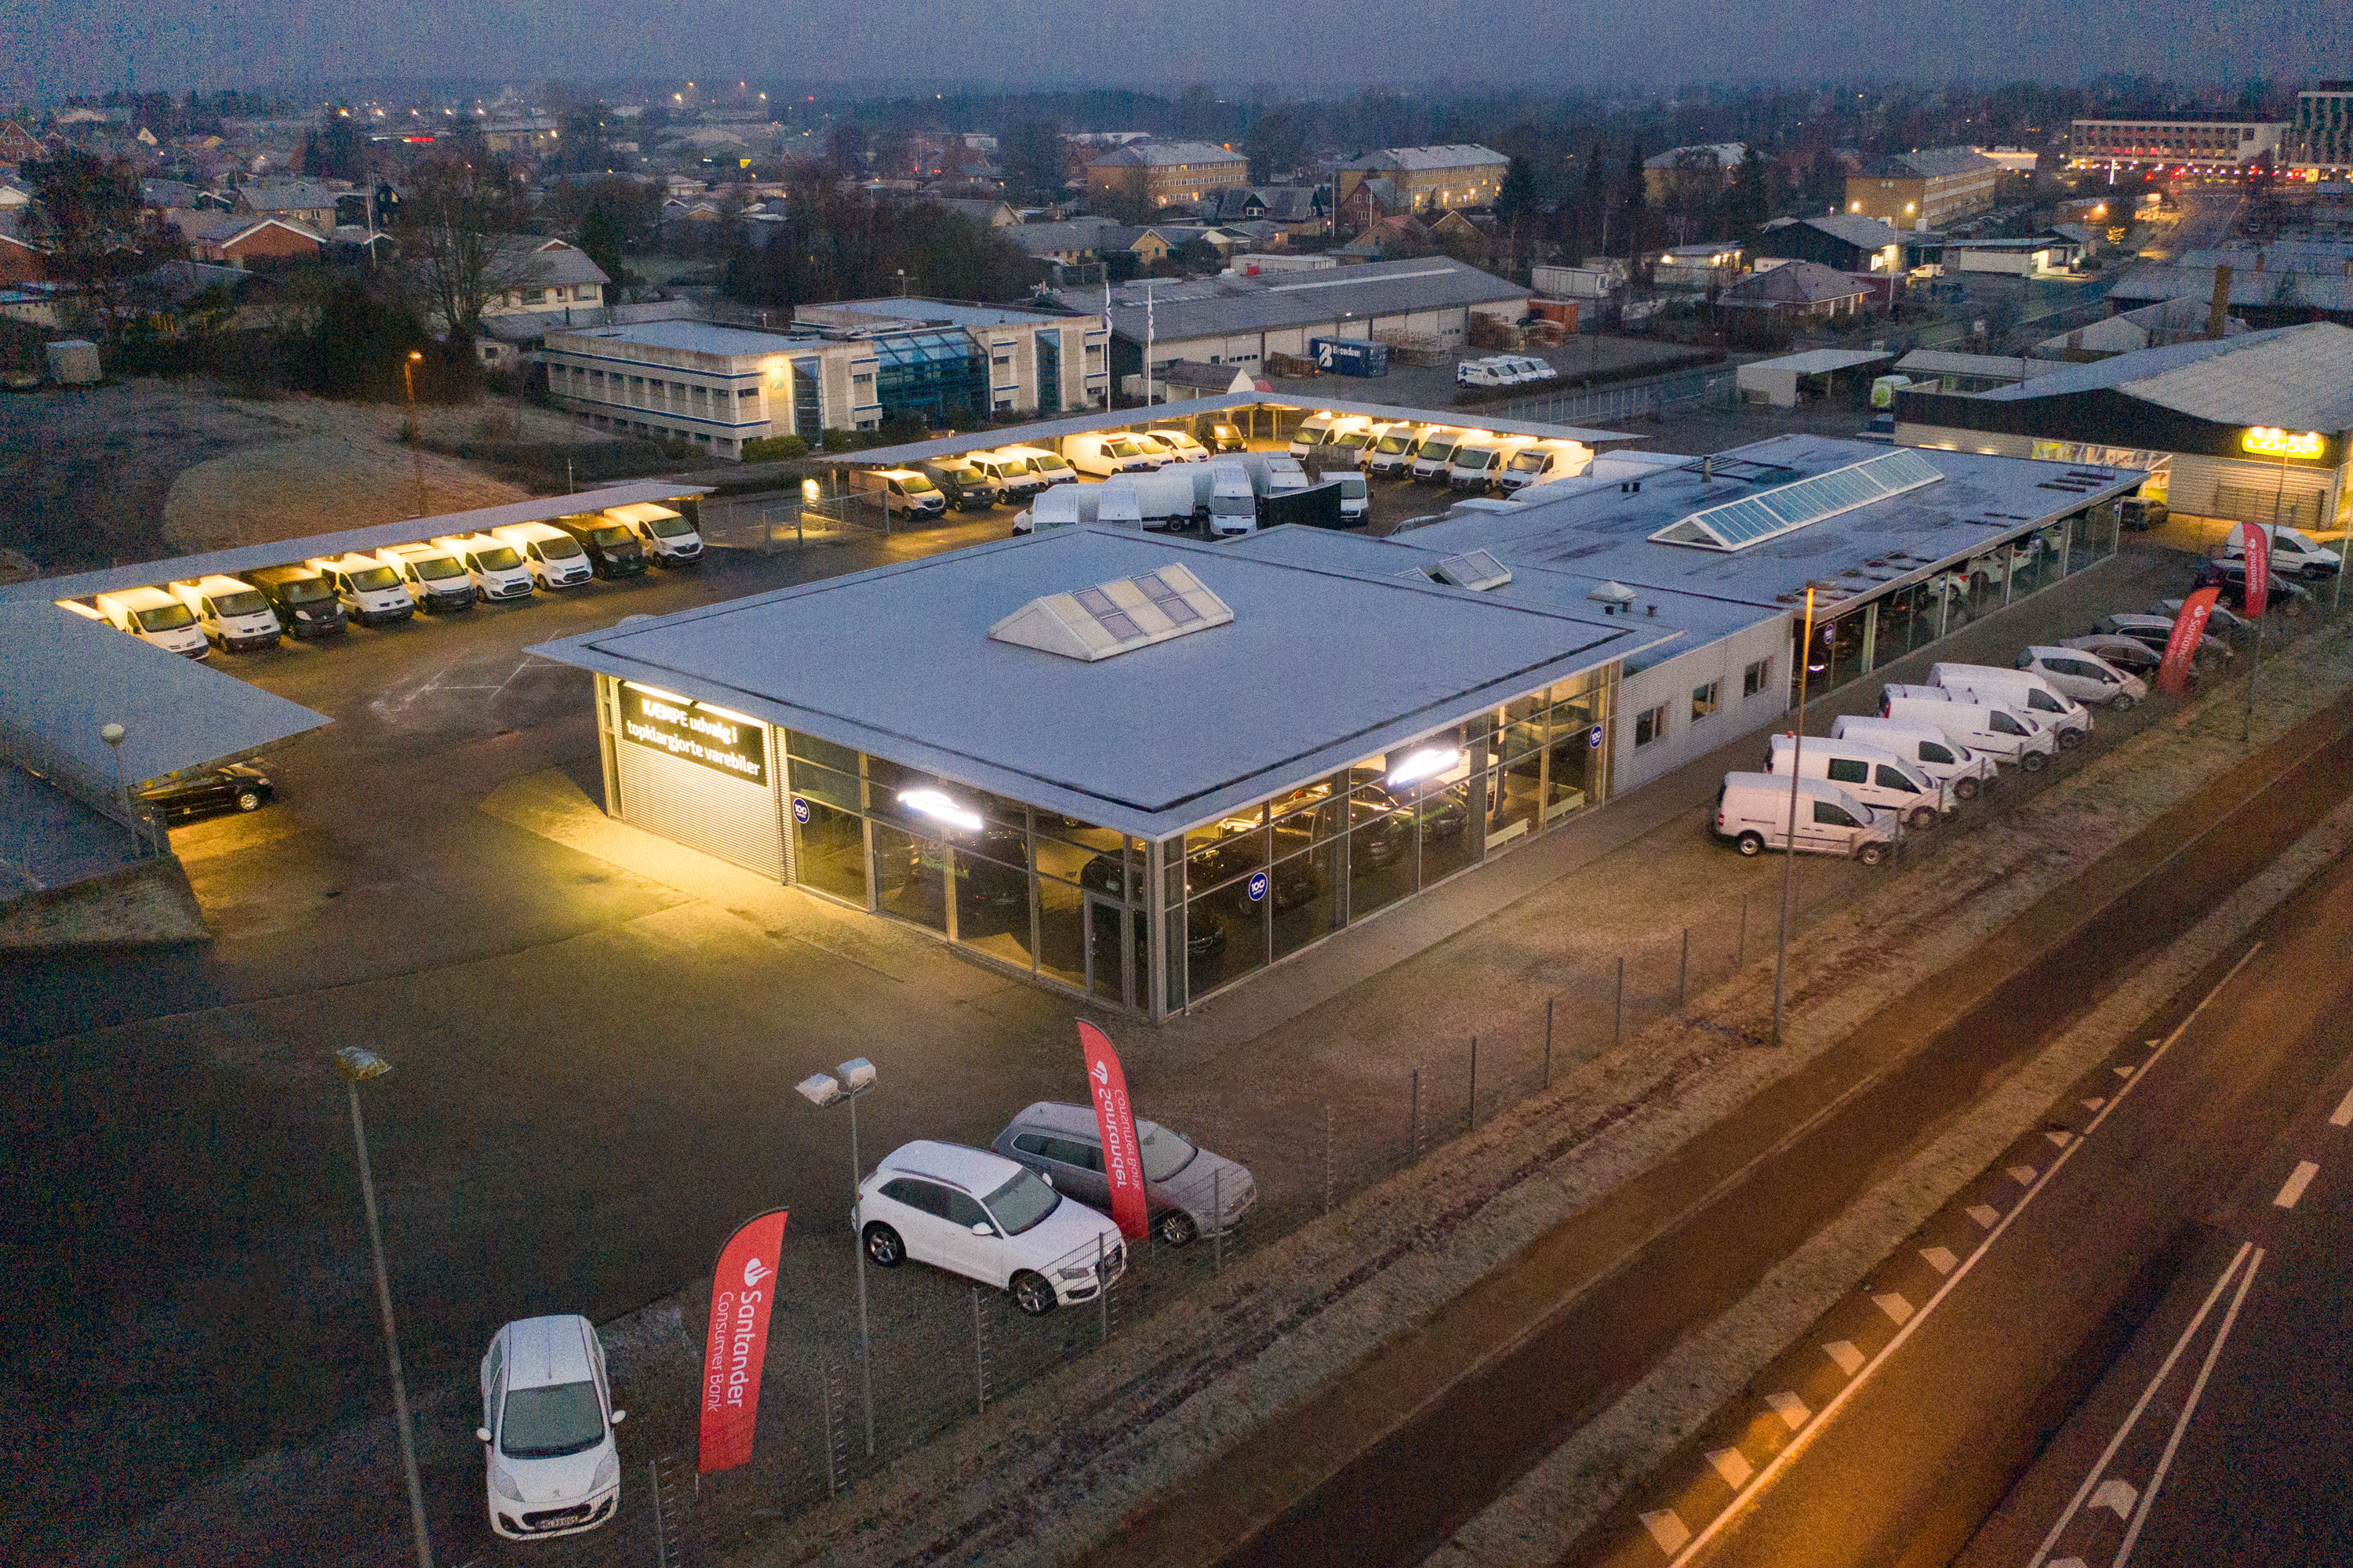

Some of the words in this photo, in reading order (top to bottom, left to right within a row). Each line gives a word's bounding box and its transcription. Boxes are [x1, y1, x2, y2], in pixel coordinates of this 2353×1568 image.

[2246, 438, 2318, 453] LOOP
[627, 719, 704, 758] topklargjorte
[704, 747, 760, 776] varebiler
[642, 698, 688, 727] KÆMPE
[689, 716, 732, 745] udvalg
[732, 726, 738, 744] i
[711, 1291, 734, 1371] Consumer
[727, 1290, 762, 1407] Santander
[707, 1373, 723, 1412] Bank
